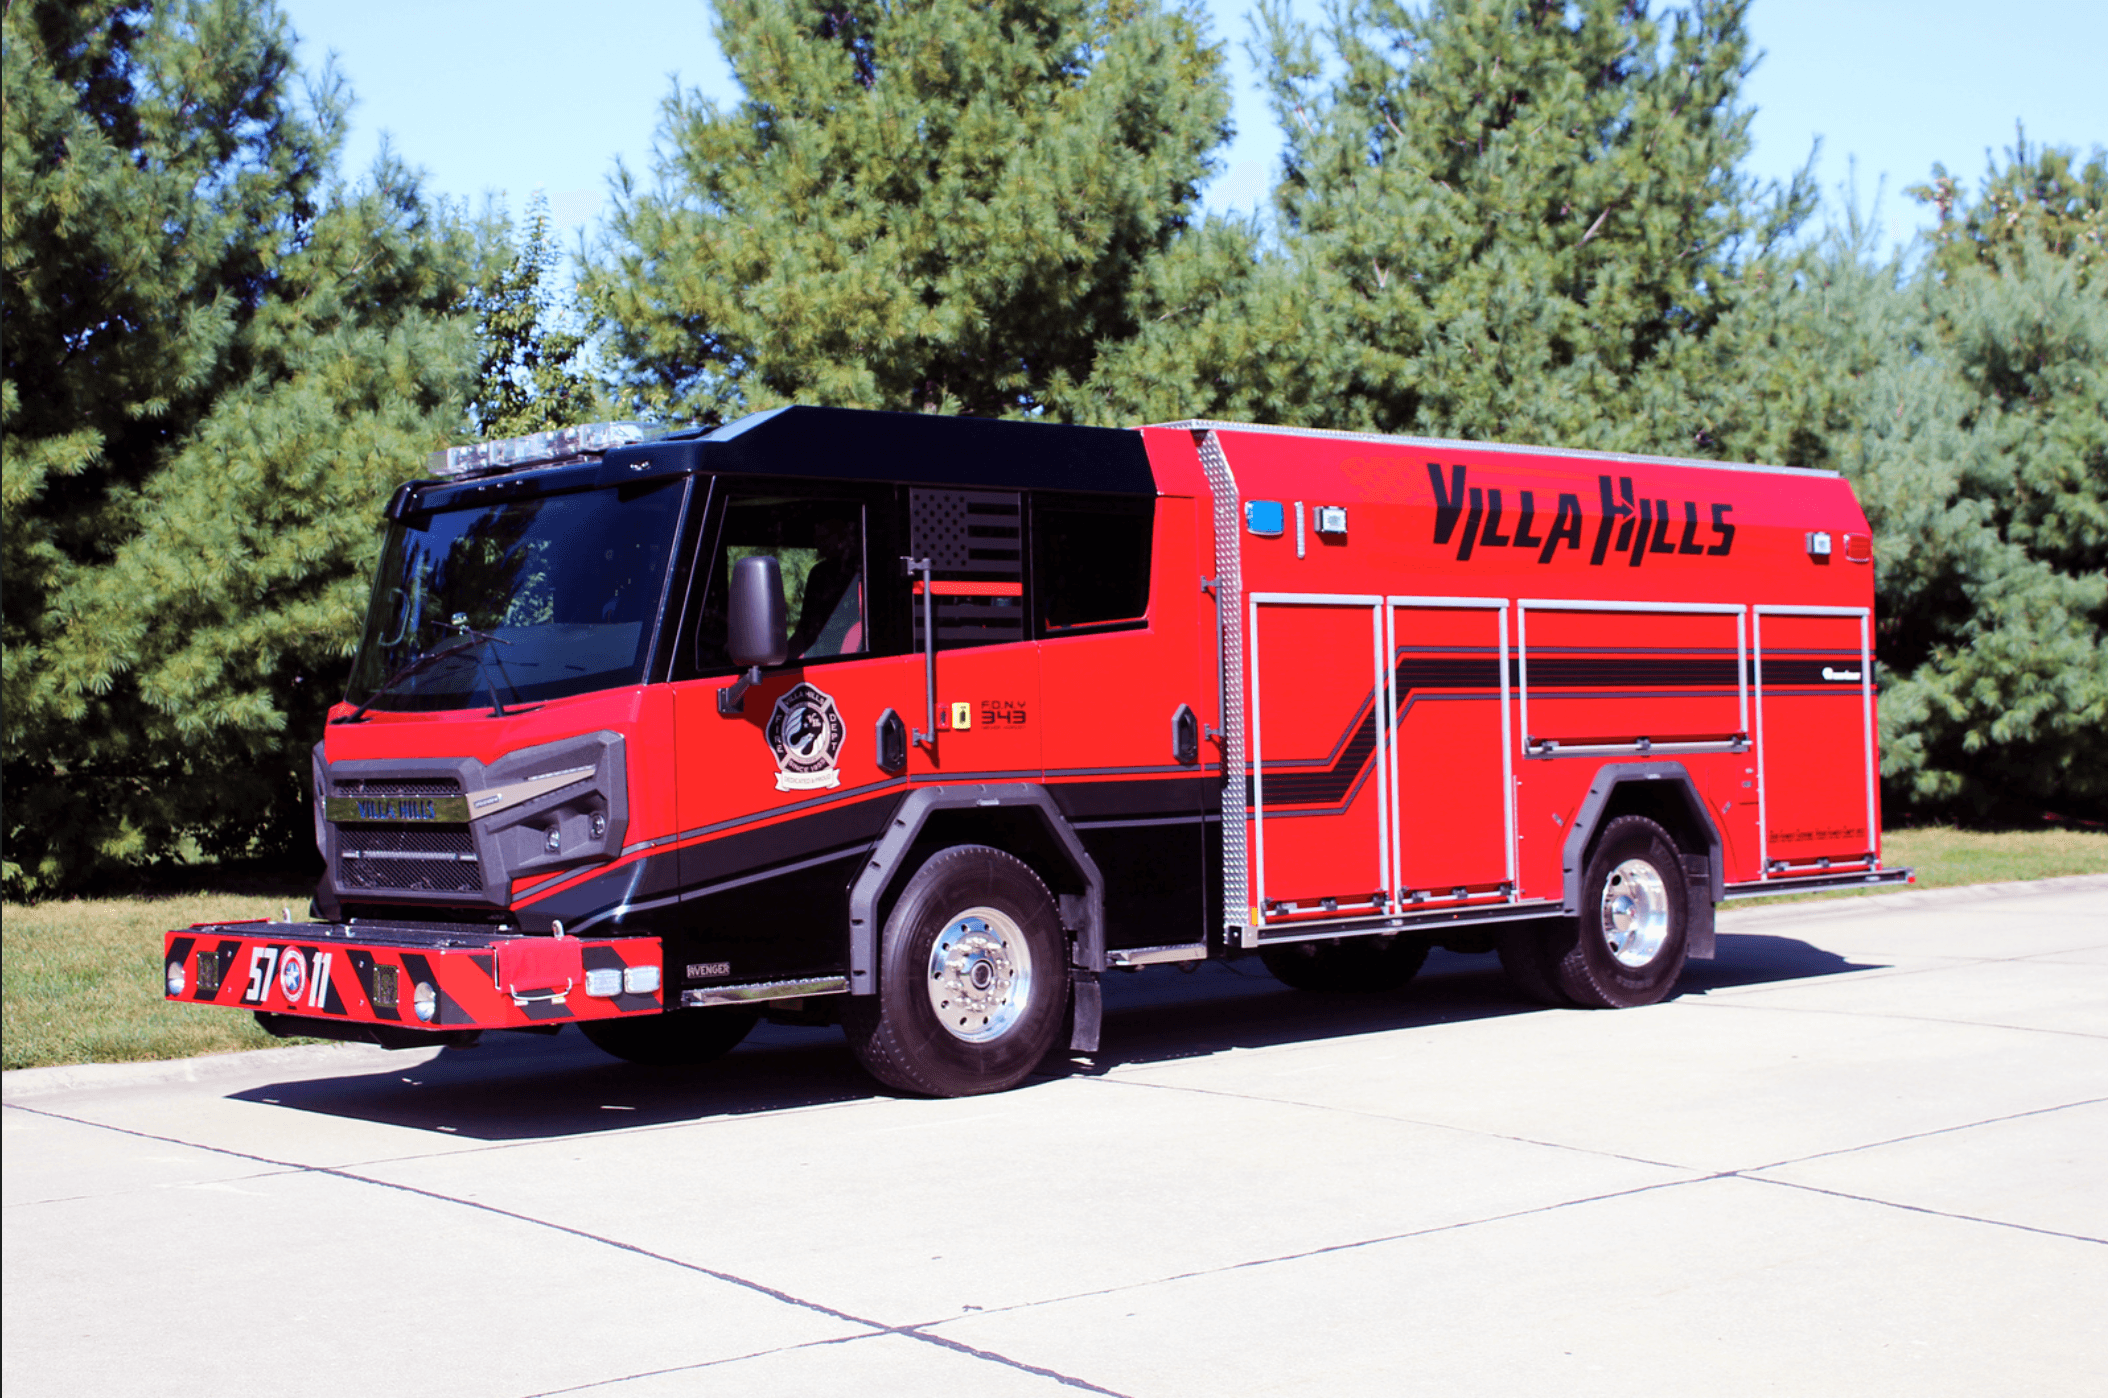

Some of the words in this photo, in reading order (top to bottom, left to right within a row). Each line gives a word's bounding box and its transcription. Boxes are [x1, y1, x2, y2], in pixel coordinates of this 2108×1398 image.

[1427, 463, 1582, 564] VILLA
[1590, 475, 1736, 567] HILLS
[784, 691, 804, 705] VILLA
[805, 691, 825, 705] HILLS
[981, 710, 1026, 725] 343
[775, 714, 784, 753] FIRE
[829, 713, 838, 751] DEPT
[787, 759, 809, 772] SINCE
[356, 800, 396, 819] VILLA
[399, 800, 436, 819] HILLS
[245, 946, 278, 1002] 57
[308, 952, 332, 1008] 11
[688, 963, 730, 977] AVENGER
